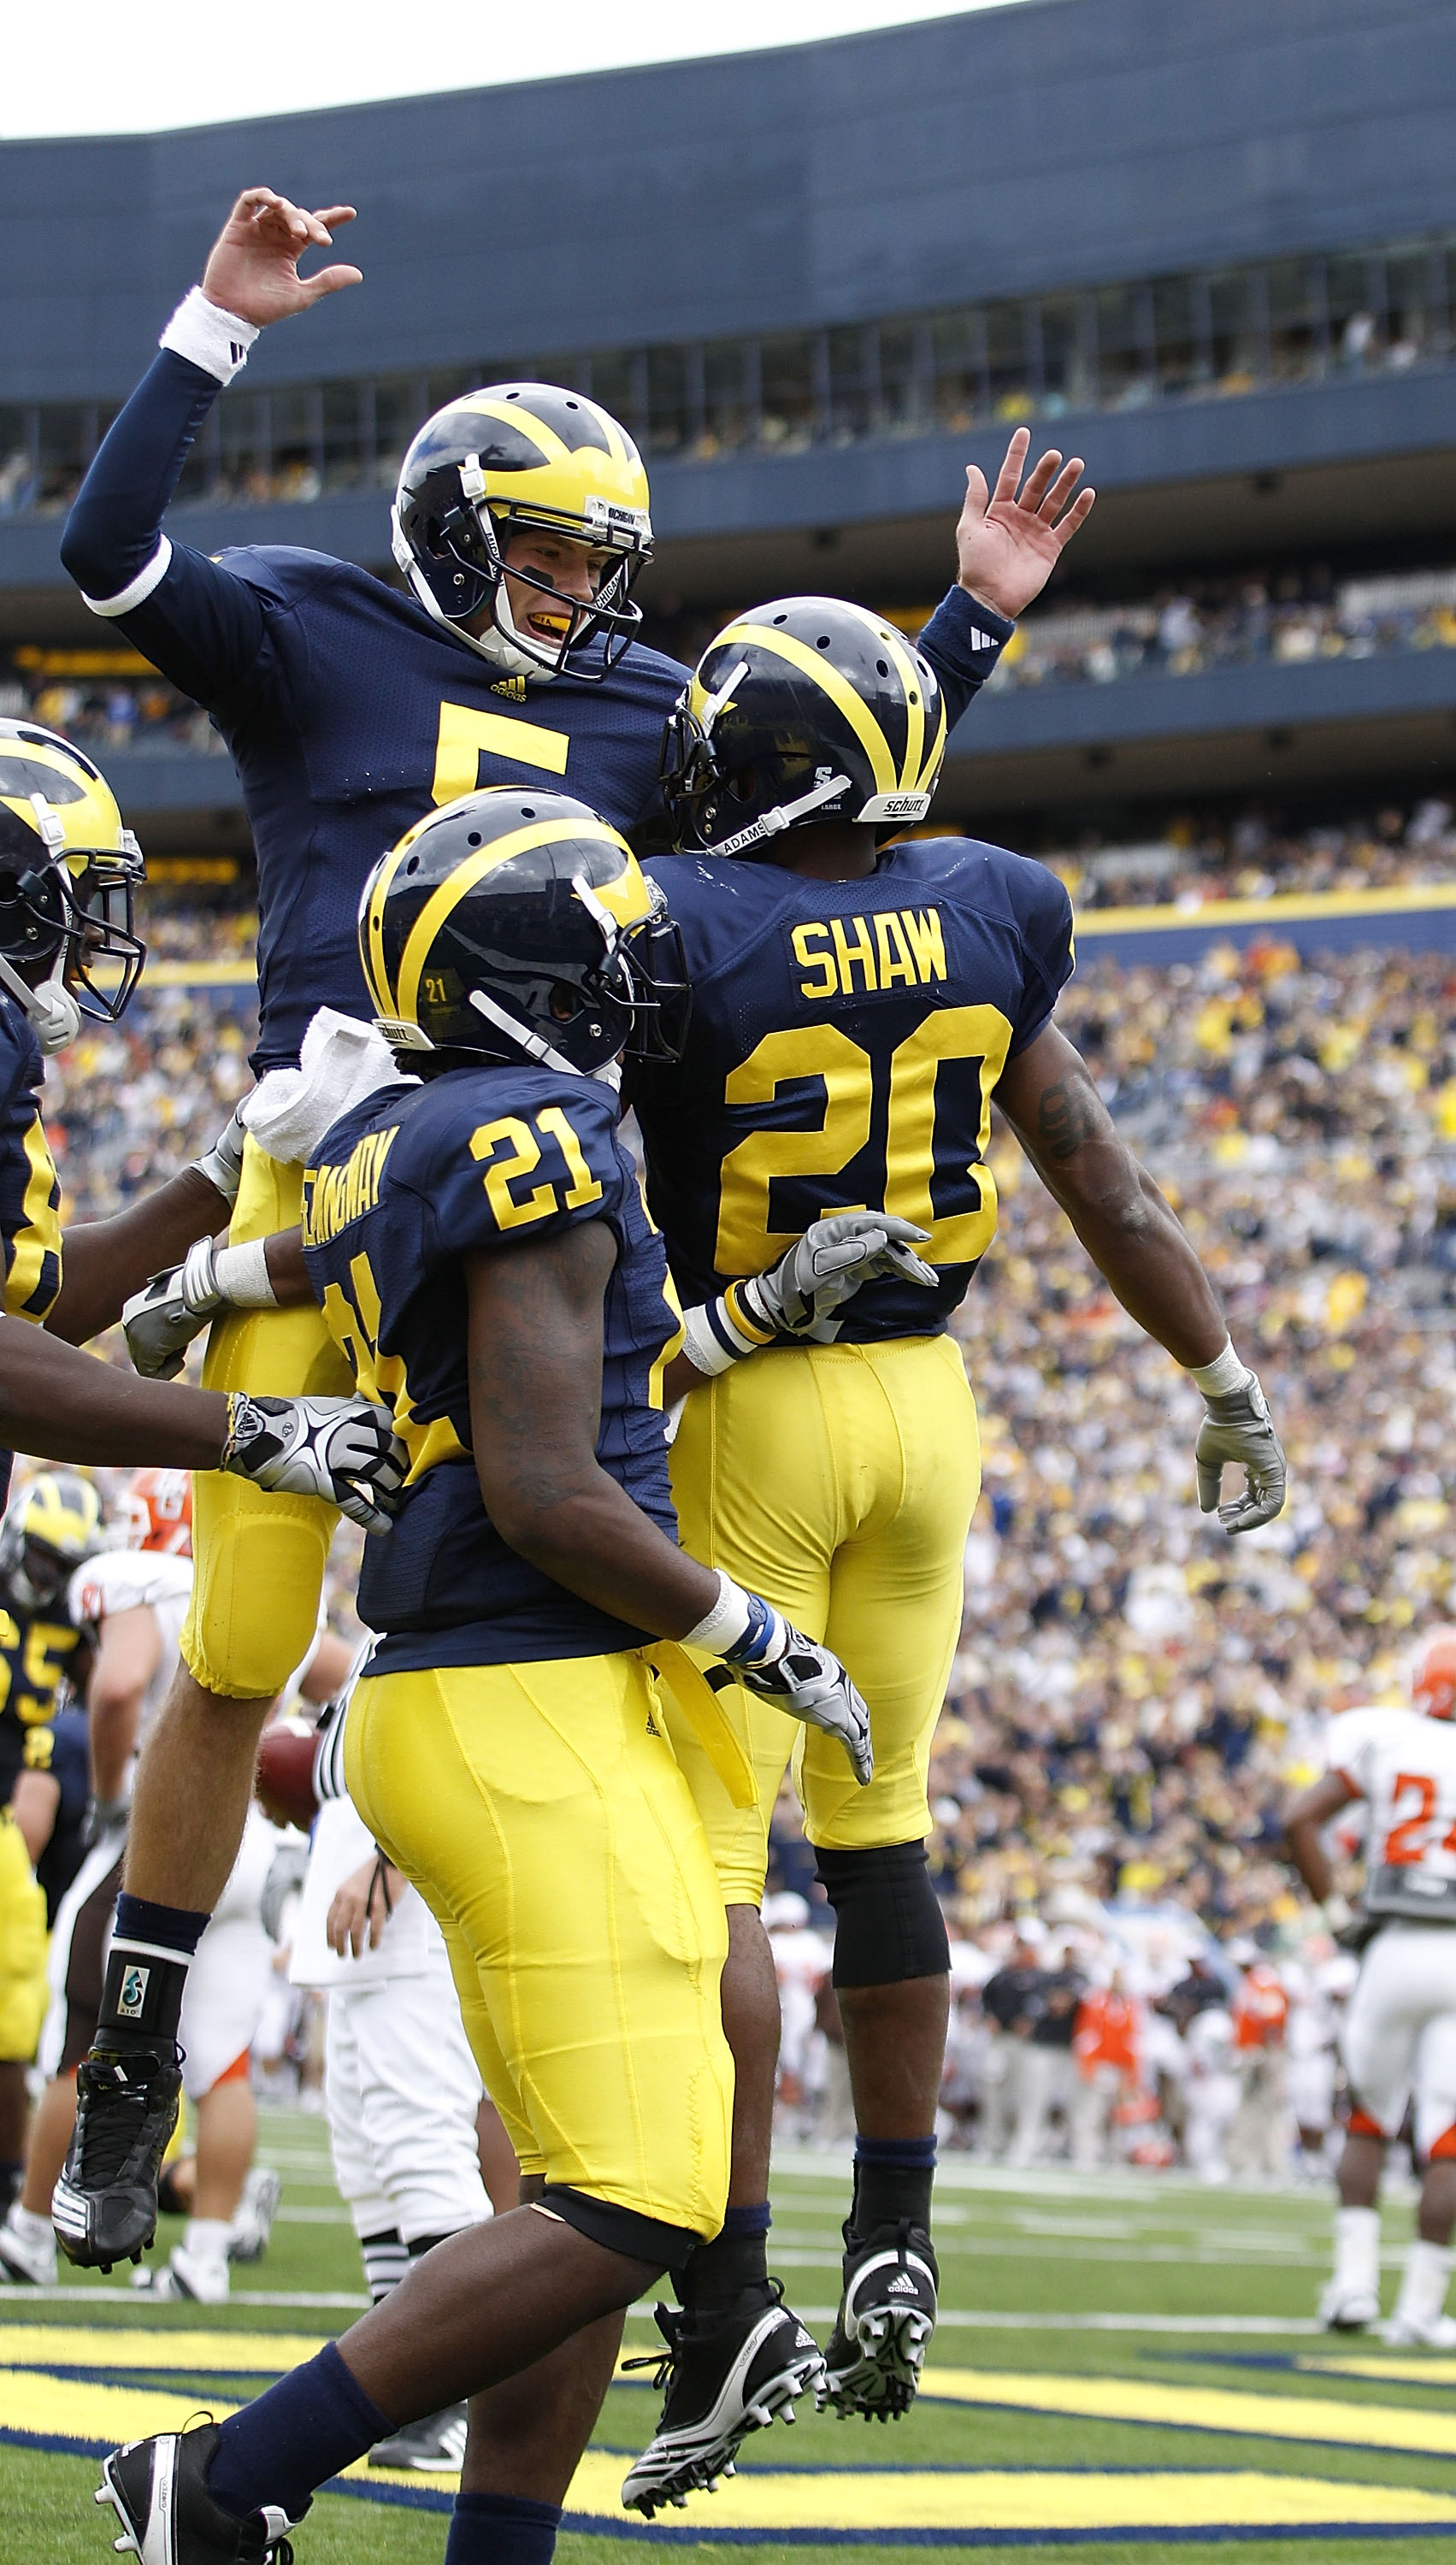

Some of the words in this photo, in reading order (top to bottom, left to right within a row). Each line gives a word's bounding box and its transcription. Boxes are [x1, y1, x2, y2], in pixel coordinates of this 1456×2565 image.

[490, 684, 528, 703] adidas
[883, 797, 925, 812] schutt
[724, 823, 766, 853] ADAMS
[790, 907, 947, 999] SHAW
[425, 977, 447, 1003] 21
[378, 1023, 410, 1041] chutt
[714, 1003, 1014, 1277] 20
[469, 1106, 604, 1232] 21
[1385, 1772, 1456, 1866] 2
[887, 2285, 919, 2296] adidas
